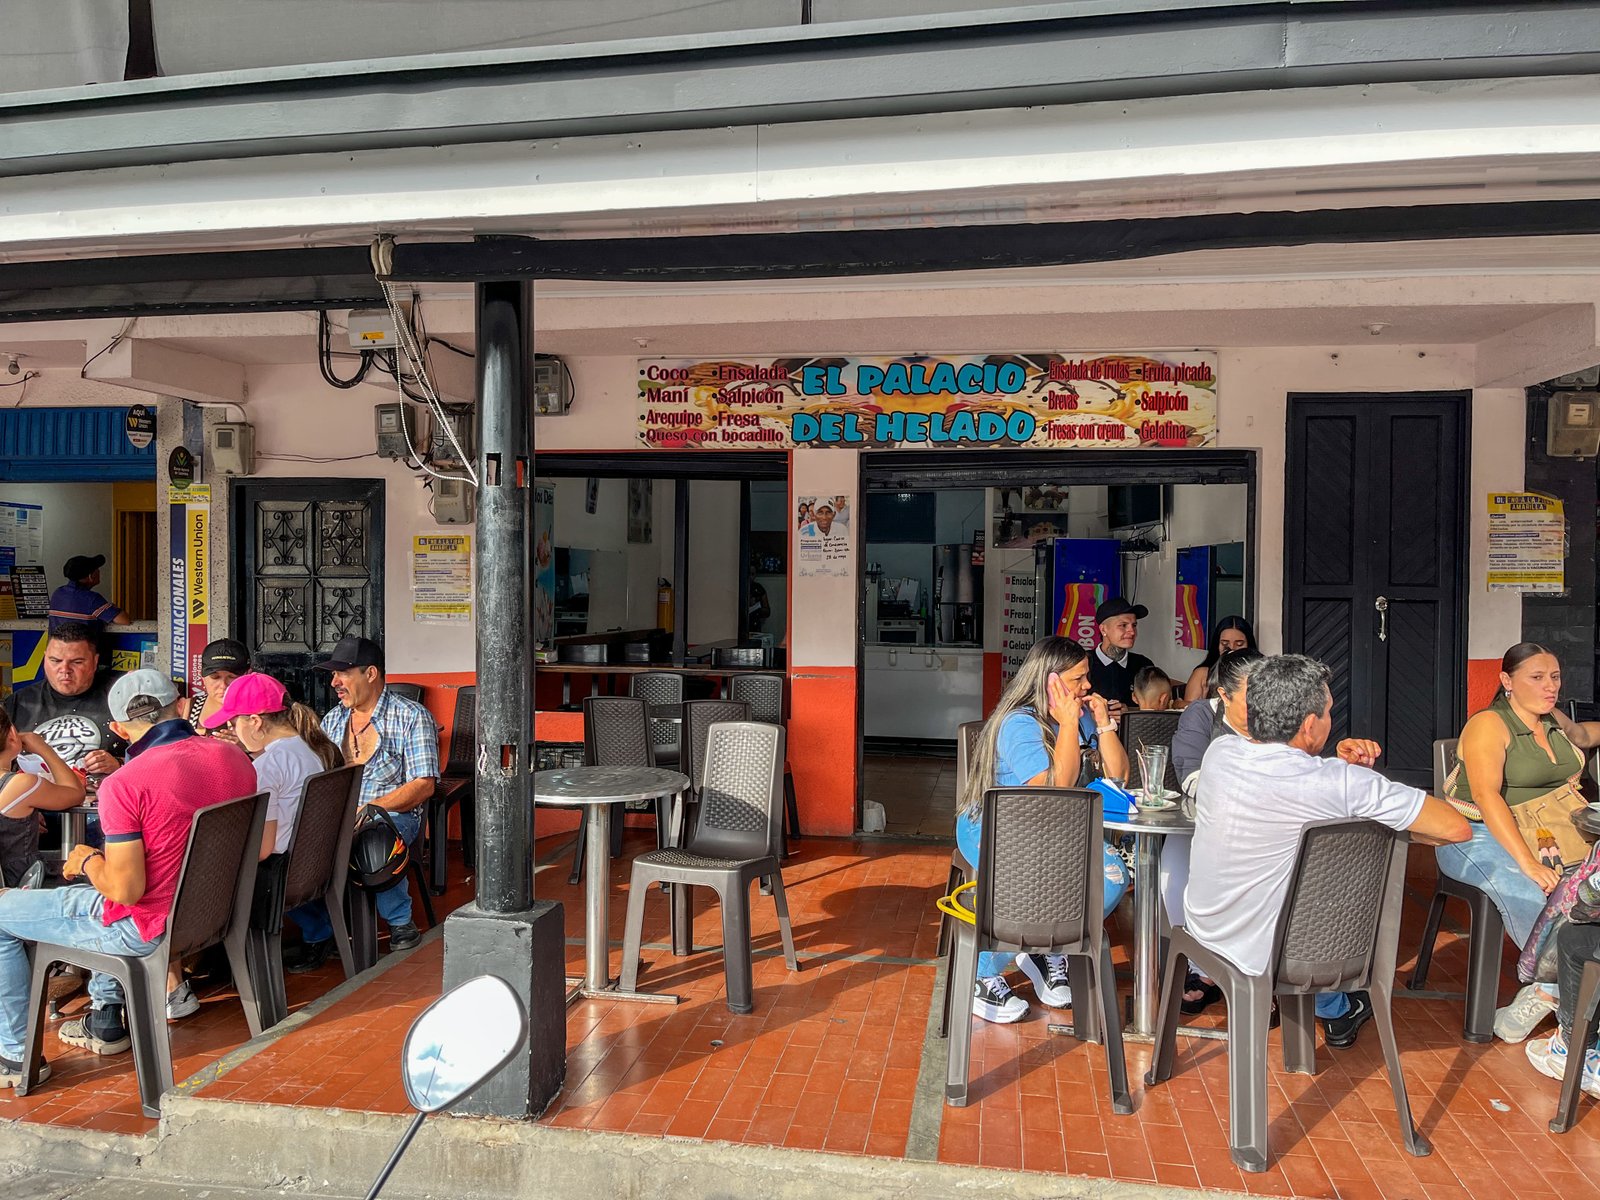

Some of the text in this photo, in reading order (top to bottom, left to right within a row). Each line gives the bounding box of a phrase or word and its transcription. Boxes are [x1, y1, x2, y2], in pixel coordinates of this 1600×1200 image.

[647, 365, 690, 381] Coco
[718, 364, 789, 381] Ensalada
[802, 362, 1027, 395] EL PALACIO
[1049, 359, 1130, 381] Ensalada de frutas
[1142, 361, 1212, 386] Fruta picada
[646, 387, 689, 403] Maní
[717, 387, 784, 407] Salpicón
[1048, 390, 1079, 411] Brevas
[1141, 390, 1188, 415] Salpicón
[646, 409, 703, 426] Arequipe
[717, 411, 761, 427] Fresa
[791, 410, 1036, 442] DEL HELADO
[646, 428, 784, 443] Queso con bocadillo
[1047, 420, 1126, 441] Fresas con crema
[1140, 420, 1187, 441] Gelatina
[193, 514, 203, 548] Union
[194, 549, 203, 596] Western
[172, 558, 185, 673] INTERNACIONALES
[1009, 609, 1032, 619] Fresas
[1009, 625, 1029, 635] Fruta
[39, 726, 96, 741] KILLS
